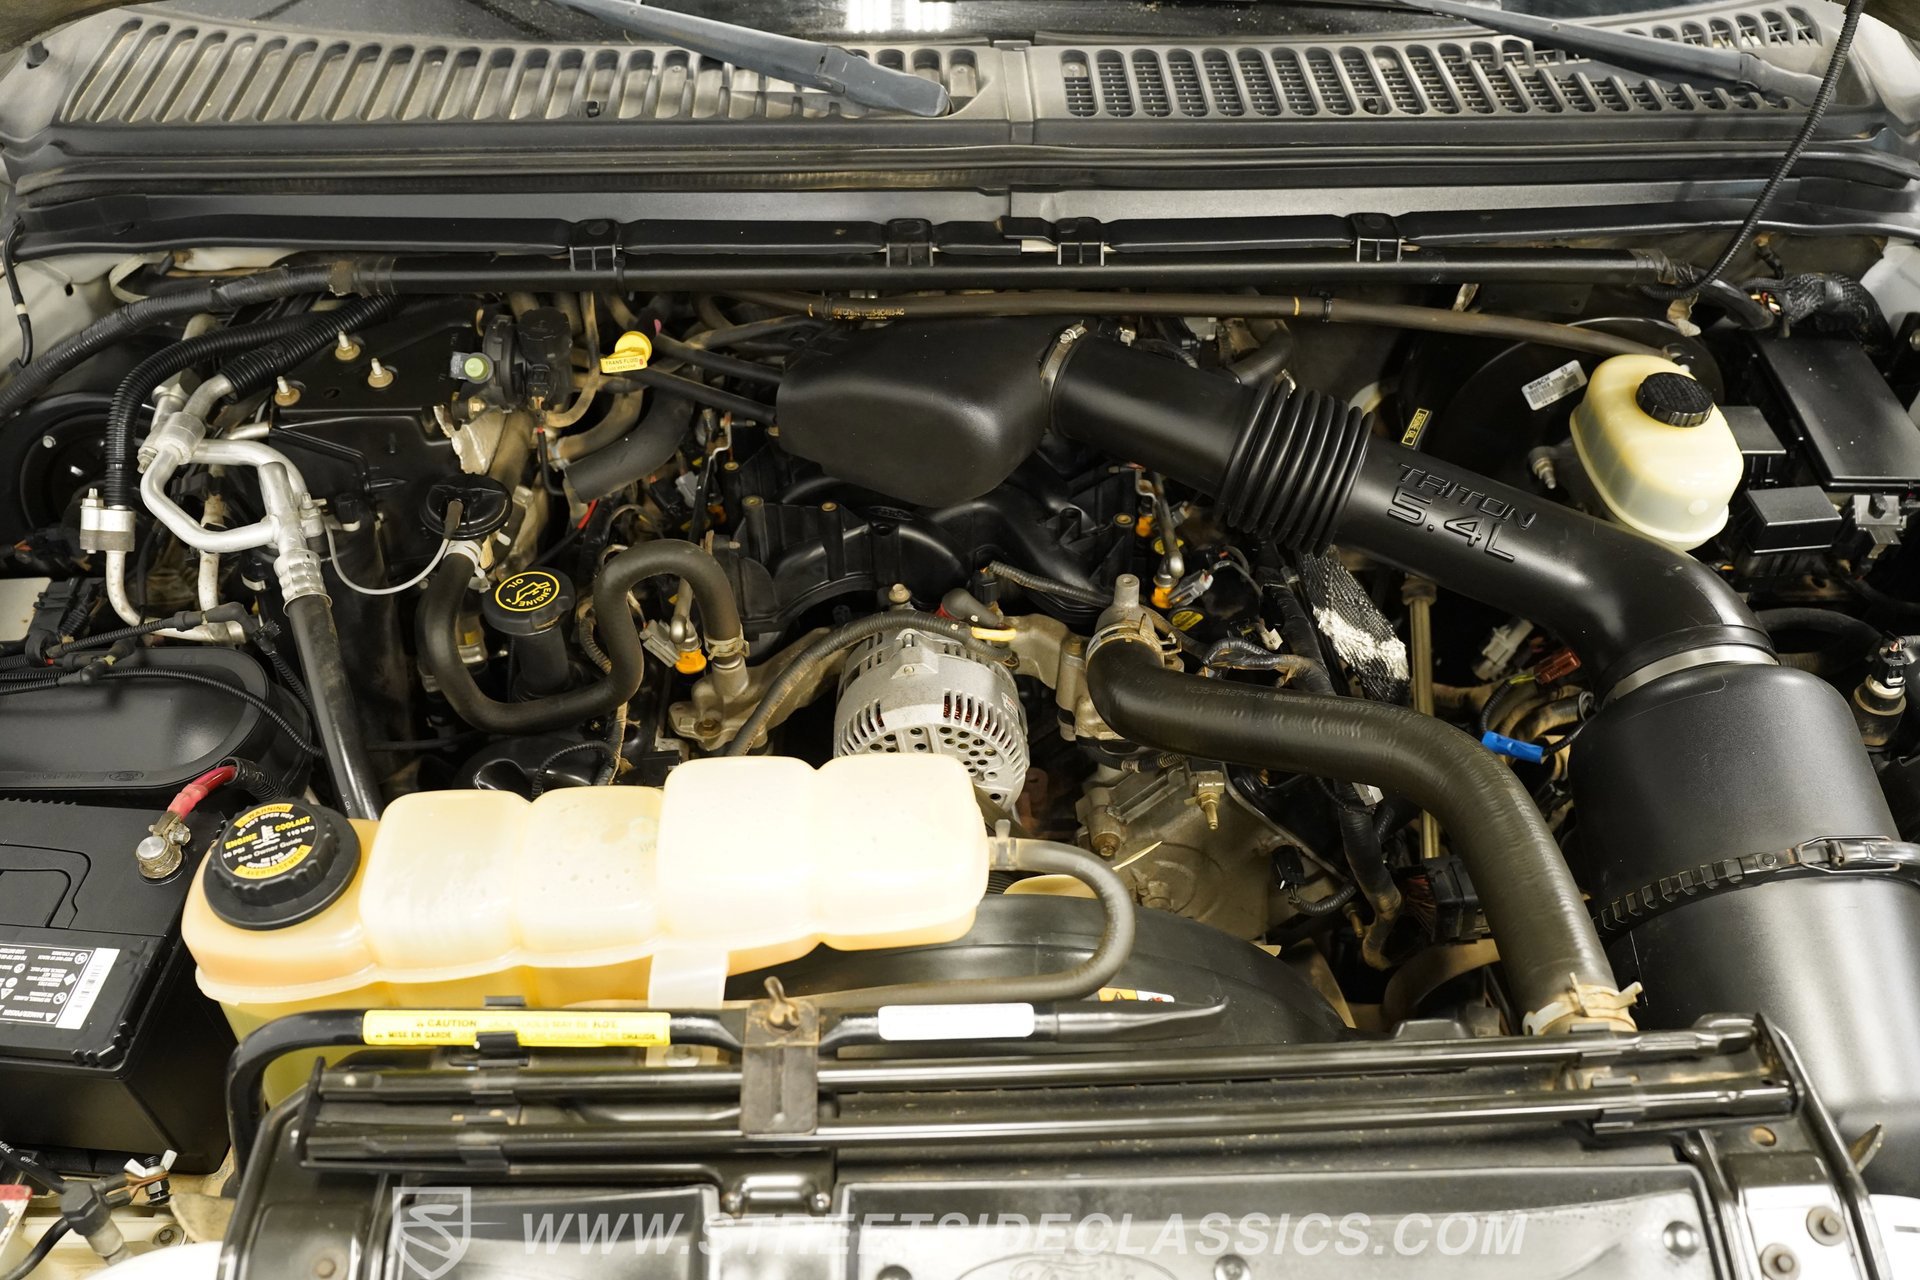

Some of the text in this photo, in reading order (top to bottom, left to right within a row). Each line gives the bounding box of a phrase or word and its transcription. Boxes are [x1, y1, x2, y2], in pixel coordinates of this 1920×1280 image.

[1527, 376, 1550, 390] BOSCH
[1399, 463, 1537, 530] TRITON
[1387, 486, 1516, 563] 5.4L
[506, 578, 524, 588] OIL
[518, 587, 552, 607] ENGINE
[248, 806, 289, 818] WARNING
[225, 815, 311, 850] ENGINE COOLANT
[237, 812, 295, 837] DO NOT OPEN HOT
[238, 837, 303, 863] See Owner Guide
[427, 1019, 477, 1027] CAUTION
